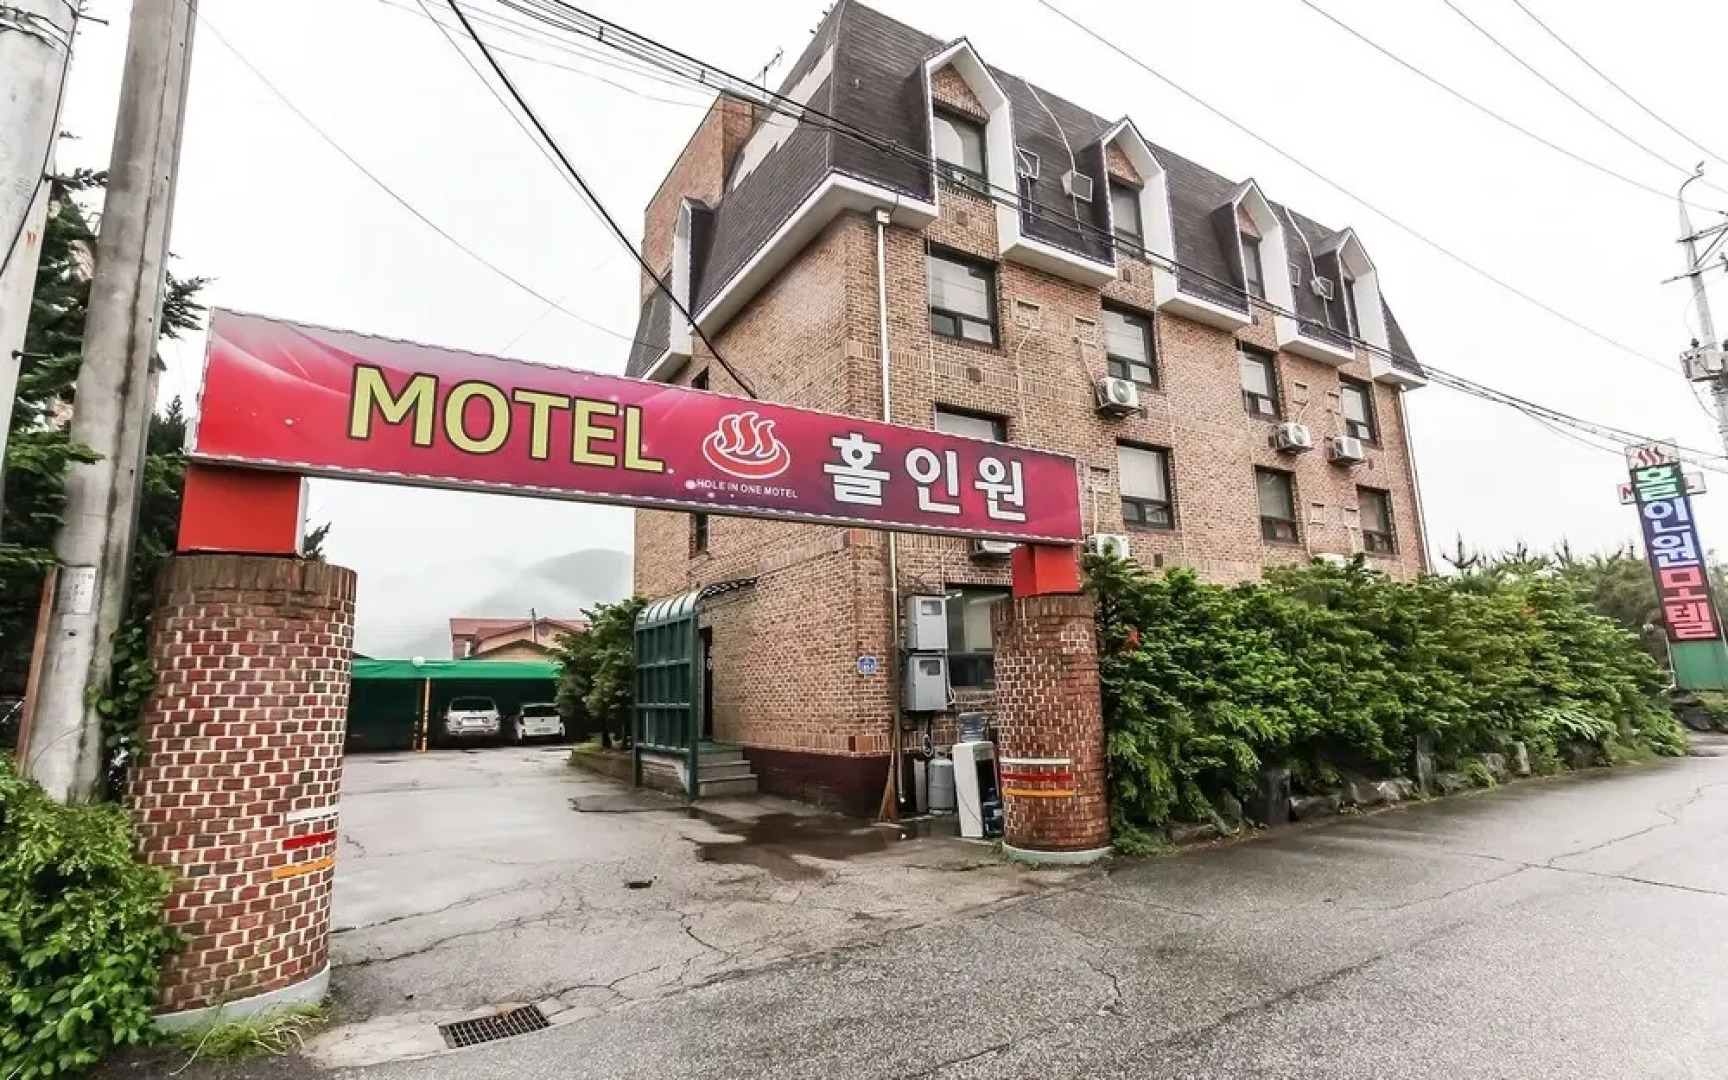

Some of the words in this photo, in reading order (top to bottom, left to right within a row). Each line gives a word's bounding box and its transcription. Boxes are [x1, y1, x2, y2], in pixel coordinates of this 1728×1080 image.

[348, 363, 665, 473] MOTEL
[696, 479, 725, 490] HOLE
[727, 483, 739, 492] IN
[741, 484, 762, 494] ONE
[764, 486, 798, 498] MOTEL
[823, 433, 1026, 522] 홀인원
